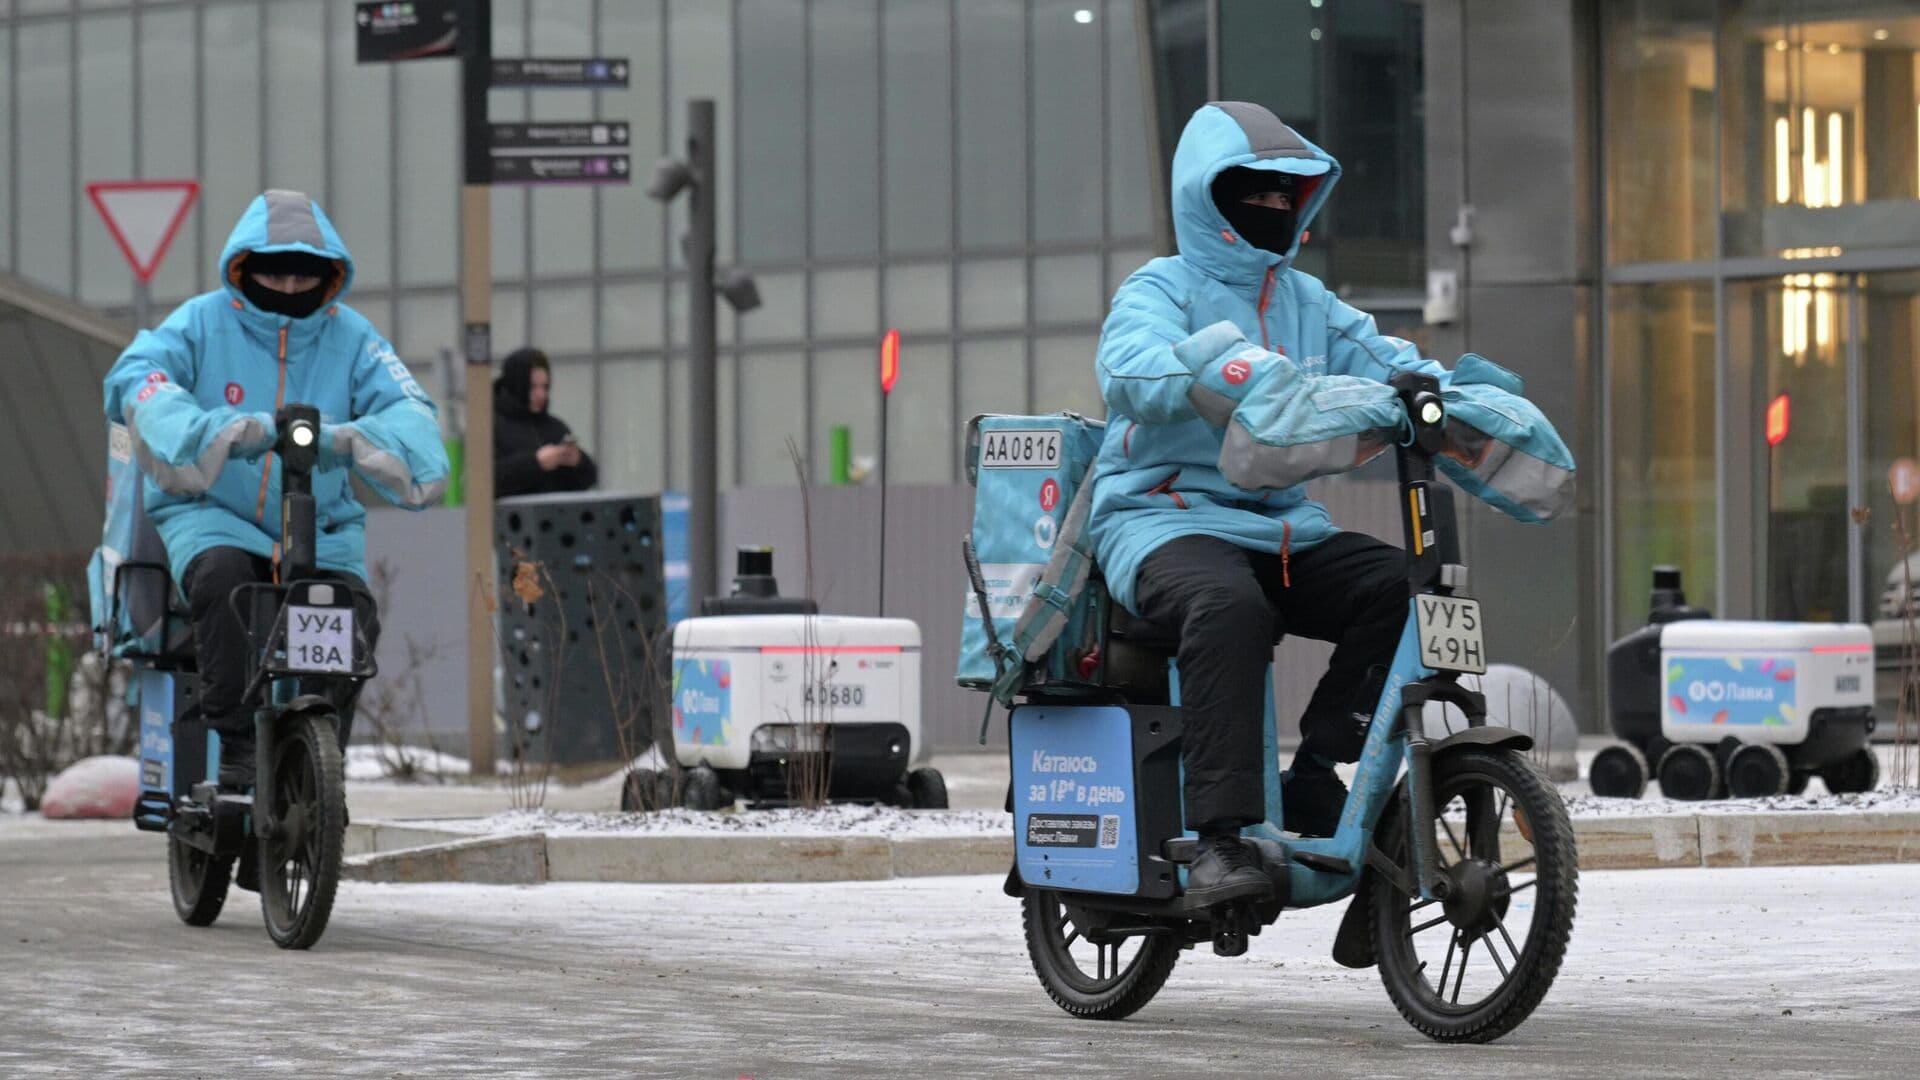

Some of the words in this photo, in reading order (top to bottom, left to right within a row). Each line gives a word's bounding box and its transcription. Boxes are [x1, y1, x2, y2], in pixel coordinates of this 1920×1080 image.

[985, 435, 1056, 461] АА0816
[297, 613, 344, 635] УУ4
[1422, 600, 1476, 631] УУ5
[298, 644, 344, 665] 18А
[1428, 635, 1481, 667] 49Н
[1032, 750, 1097, 773] Катаюсь
[1029, 784, 1048, 802] за
[1076, 786, 1087, 803] в
[1087, 786, 1125, 806] день
